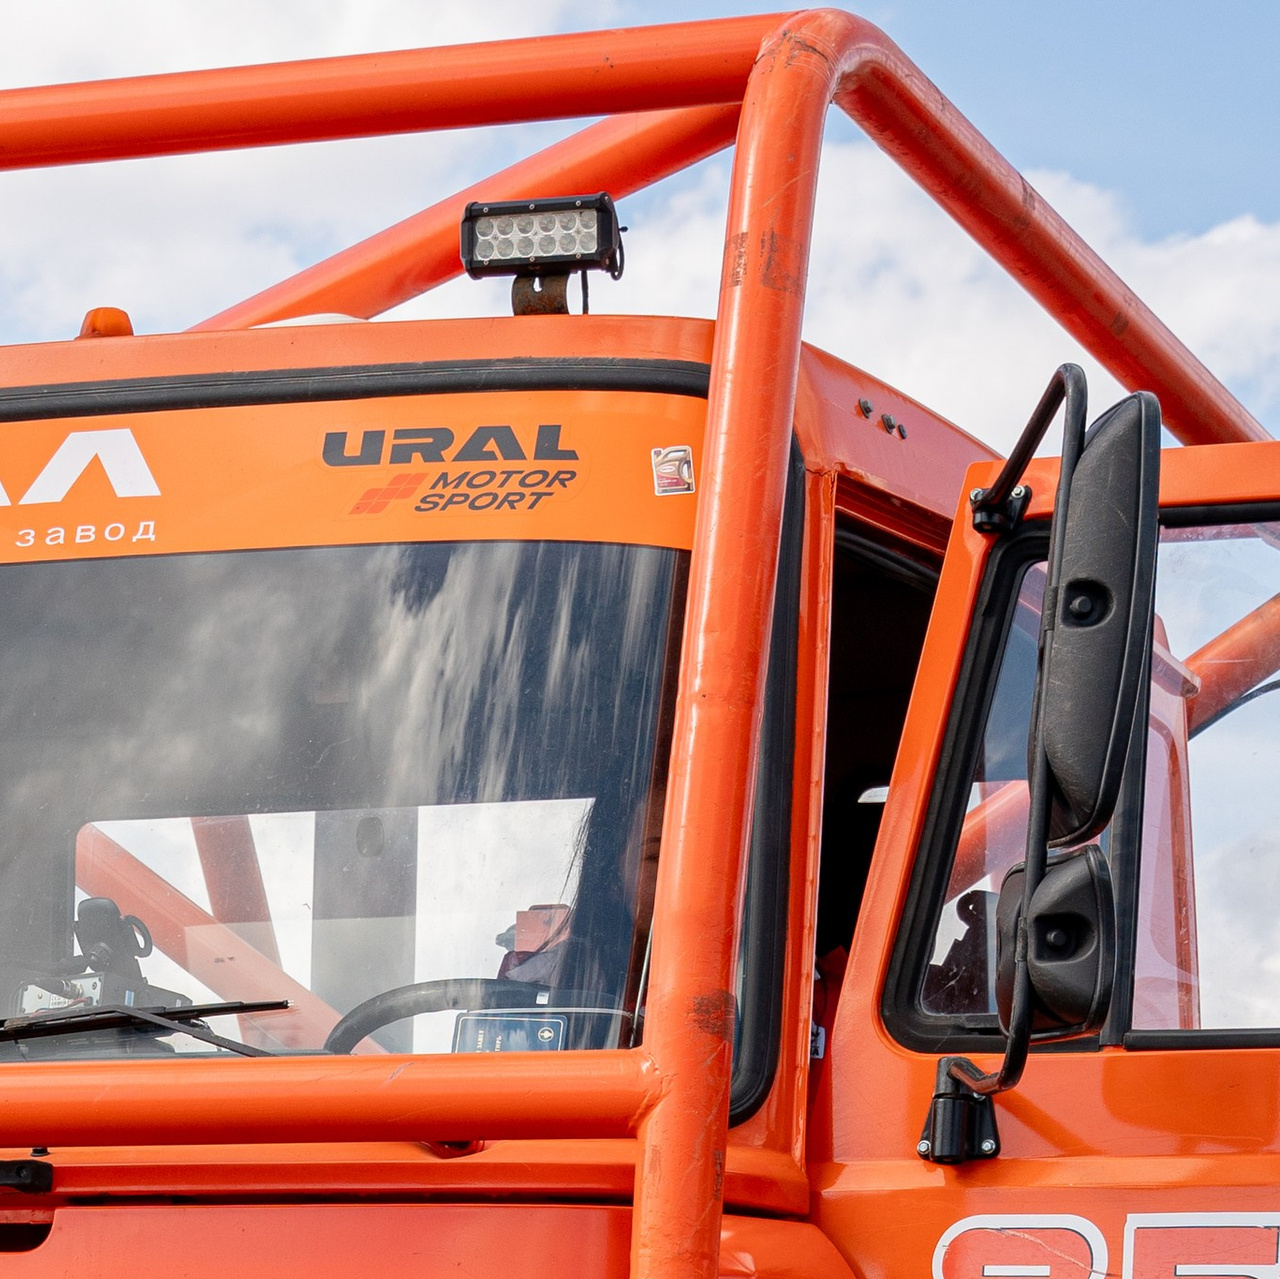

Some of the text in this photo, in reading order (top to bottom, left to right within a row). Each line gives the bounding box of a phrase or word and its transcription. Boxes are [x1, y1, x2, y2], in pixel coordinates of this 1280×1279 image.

[321, 424, 580, 467] URAL
[431, 469, 577, 490] MOTOR
[415, 491, 555, 512] SPORT
[15, 519, 157, 548] завод
